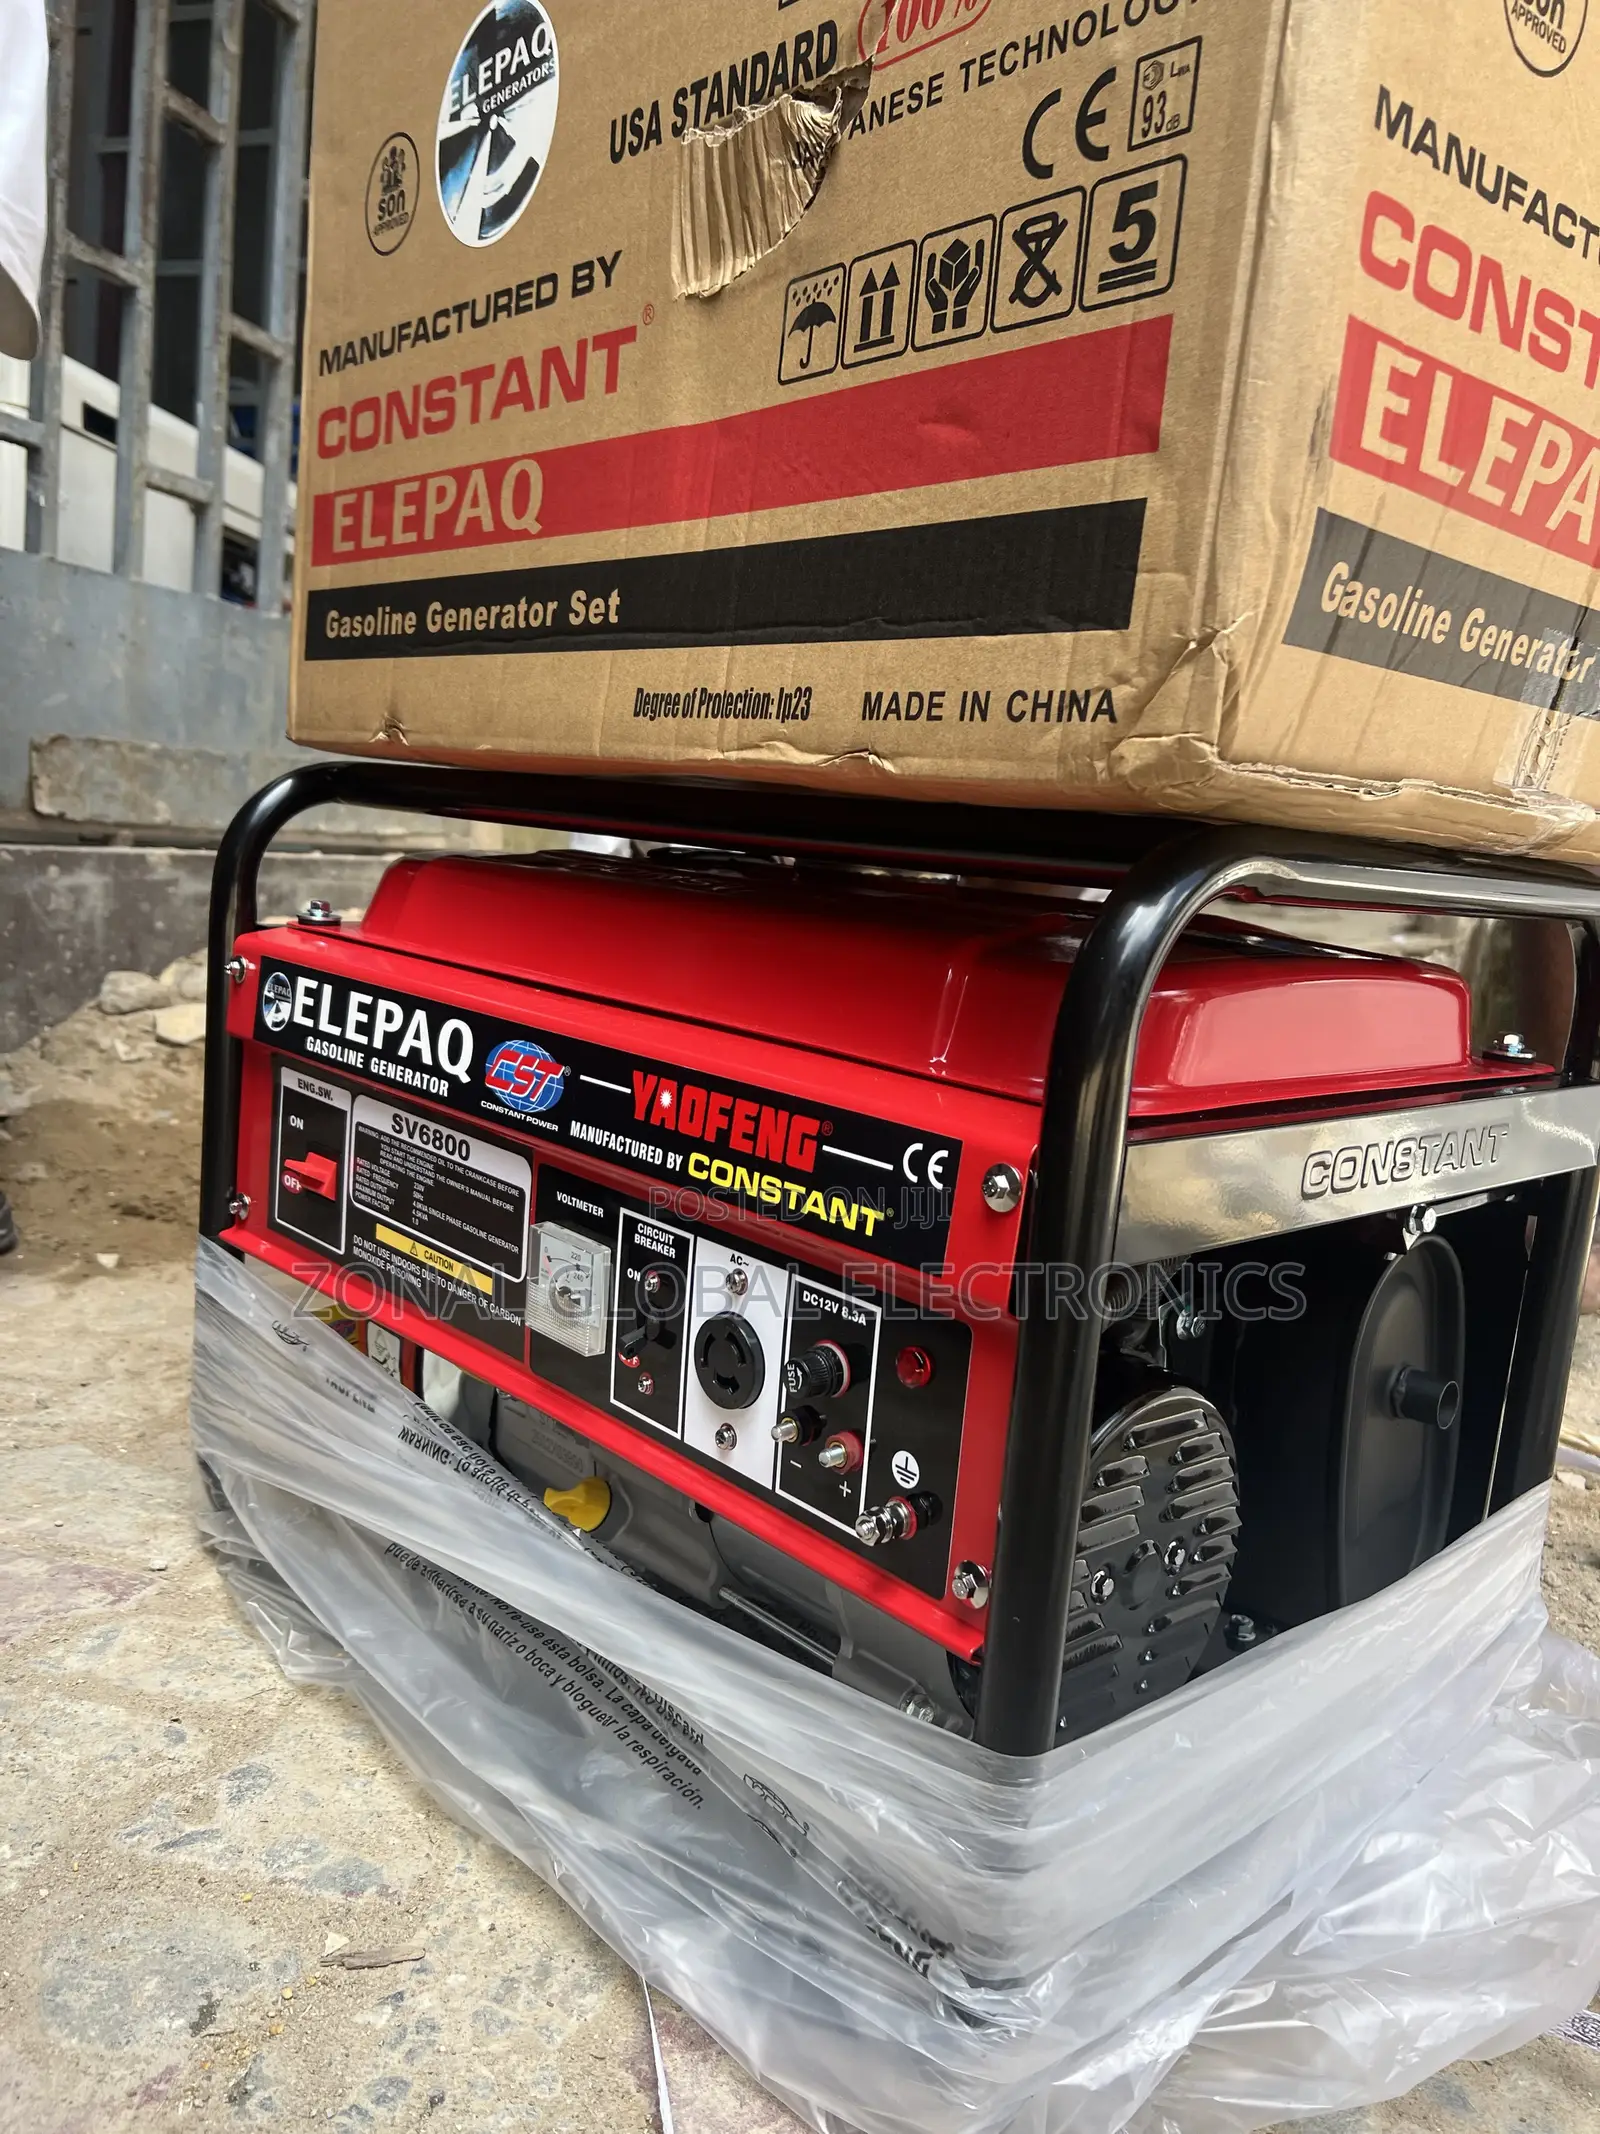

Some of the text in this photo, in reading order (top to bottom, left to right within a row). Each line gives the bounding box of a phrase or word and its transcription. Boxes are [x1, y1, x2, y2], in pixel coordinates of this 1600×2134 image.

[1511, 0, 1567, 54] APPROVED
[449, 22, 553, 115] ELEPAQ
[482, 58, 555, 114] GENERATORS
[609, 20, 838, 164] USA STANDARD
[1374, 84, 1600, 265] MANUFACT
[319, 250, 623, 376] MANUFACTURED BY
[332, 459, 544, 554] ELEPAQ
[325, 588, 621, 639] Gasoline Generator Set
[1321, 561, 1595, 683] Gasoline Generator
[633, 687, 681, 721] Degree
[681, 687, 698, 719] of
[697, 687, 775, 720] Protection:
[862, 689, 1118, 723] MADE IN CHINA
[293, 976, 474, 1084] ELEPAQ
[297, 1078, 333, 1101] ENG.SW.
[306, 1036, 449, 1097] GASOLINE GENERATOR
[485, 1049, 566, 1102] CST
[289, 1115, 304, 1130] ON
[391, 1113, 471, 1162] SV6800
[480, 1100, 559, 1132] CONSTANT POWER
[633, 1070, 820, 1173] YAOFENG
[380, 1158, 406, 1174] OPERATING
[406, 1169, 416, 1178] THE
[391, 1147, 406, 1159] START
[406, 1153, 416, 1163] THE
[391, 1139, 400, 1147] THE
[447, 1161, 454, 1170] TO
[454, 1164, 464, 1175] THE
[465, 1169, 496, 1188] CRANKCASE
[497, 1183, 520, 1197] BEFORE
[570, 1120, 663, 1165] MANUFACTURED
[667, 1151, 683, 1171] BY
[1301, 1123, 1510, 1199] CONSTANT
[371, 1164, 391, 1178] VOLTAGE
[372, 1172, 399, 1189] FREQUENCY
[403, 1160, 435, 1178] UNDERSTAND
[435, 1173, 446, 1184] THE
[470, 1188, 491, 1203] MANUAL
[492, 1197, 515, 1212] BEFORE
[371, 1198, 390, 1212] FACTOR
[556, 1191, 604, 1219] VOLTMETER
[445, 1215, 462, 1228] PHASE
[462, 1222, 487, 1240] GASOLINE
[487, 1234, 519, 1254] GENERATOR
[634, 1233, 676, 1259] BREAKER
[637, 1223, 674, 1245] CIRCUIT
[353, 1246, 421, 1288] MONOXIDE POISONING
[353, 1234, 521, 1326] DO NOT USE INDOORS DUE TO DANGER OF CARBON
[424, 1249, 454, 1272] CAUTION
[627, 1267, 641, 1282] ON
[803, 1290, 867, 1326] DC12V 8.3A
[787, 1363, 797, 1393] FUSE
[384, 1541, 420, 1570] puede
[468, 1602, 475, 1616] a
[477, 1608, 492, 1624] su
[488, 1619, 519, 1648] nariz
[516, 1644, 527, 1654] o
[523, 1648, 556, 1678] boca
[550, 1673, 566, 1688] y
[613, 1725, 631, 1741] la
[626, 1739, 704, 1810] respiración.
[506, 1610, 545, 1639] re-use
[567, 1656, 604, 1692] bolsa.
[604, 1687, 624, 1704] La
[621, 1701, 653, 1731] capa
